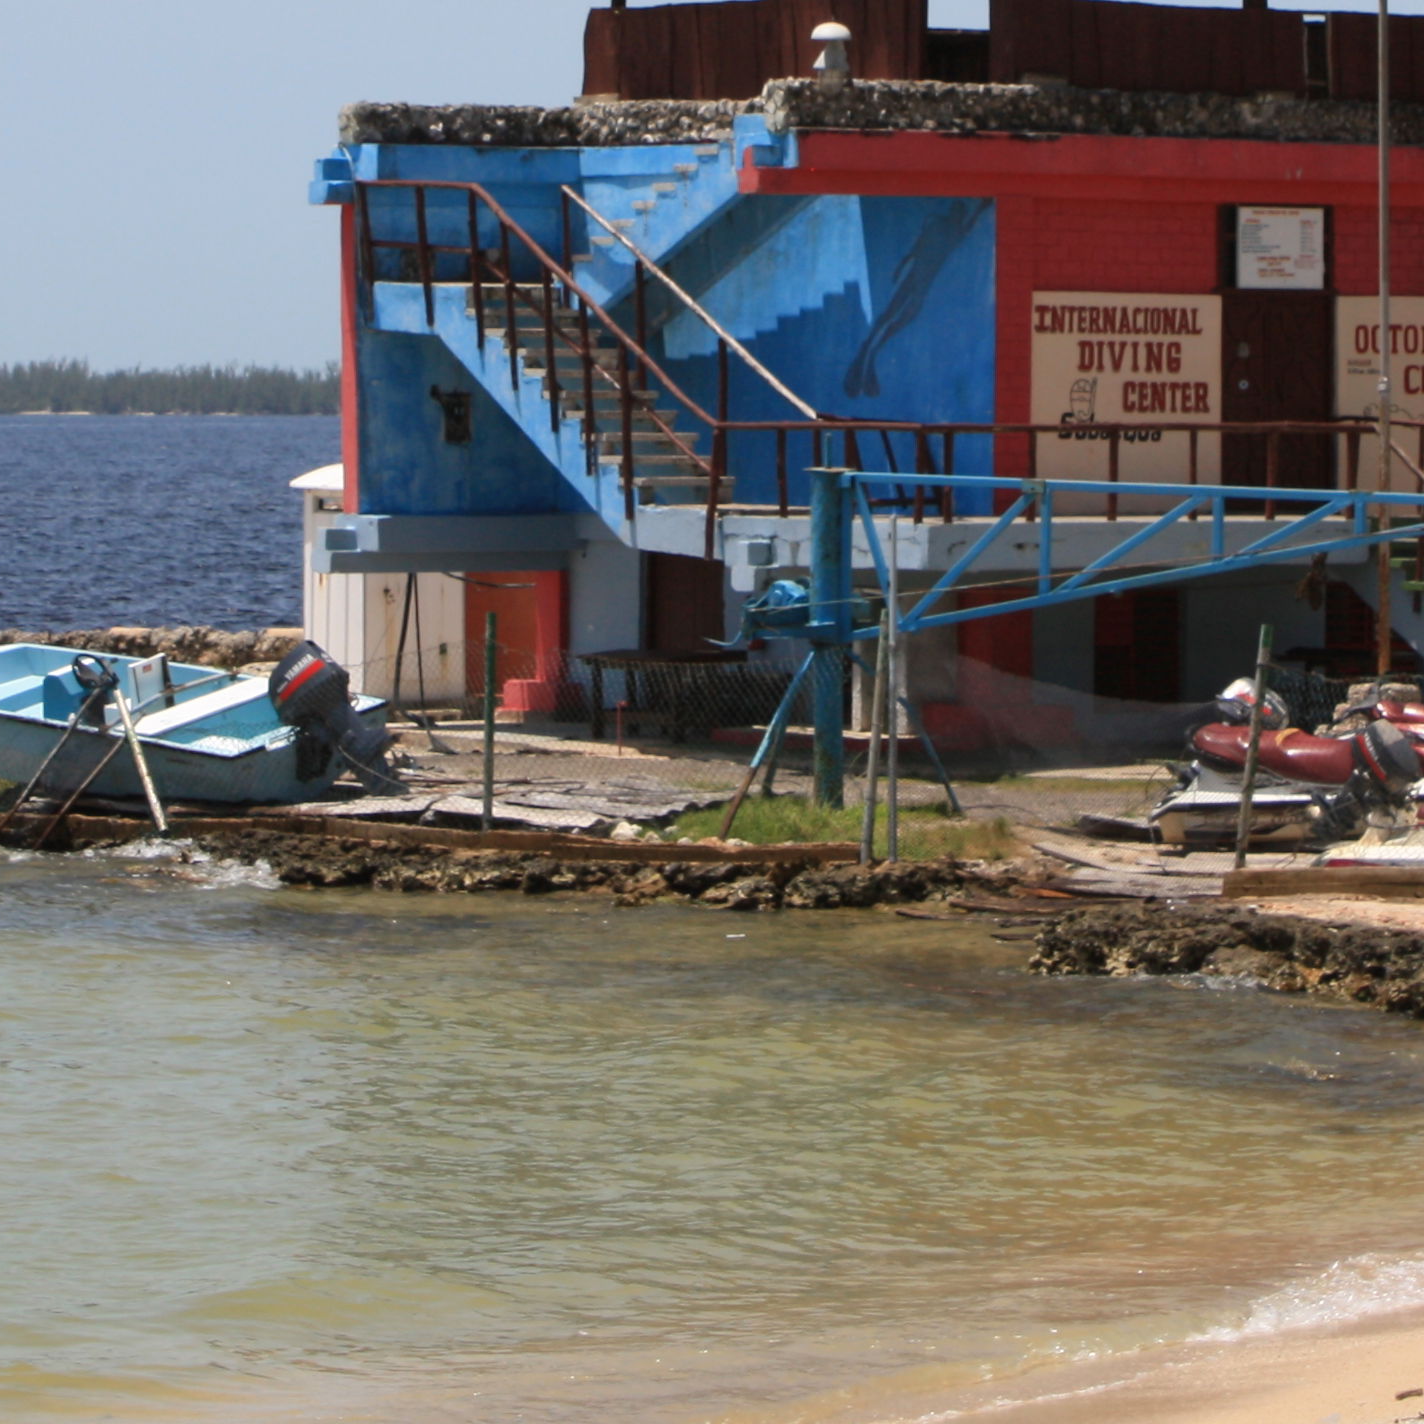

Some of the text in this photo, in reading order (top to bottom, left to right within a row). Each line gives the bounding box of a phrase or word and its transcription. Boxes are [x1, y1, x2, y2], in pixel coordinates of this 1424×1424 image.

[1035, 305, 1202, 335] INTERNACIONAL
[1078, 340, 1181, 373] DIVING
[1122, 381, 1210, 413] CENTER
[284, 653, 314, 681] YAMAHA
